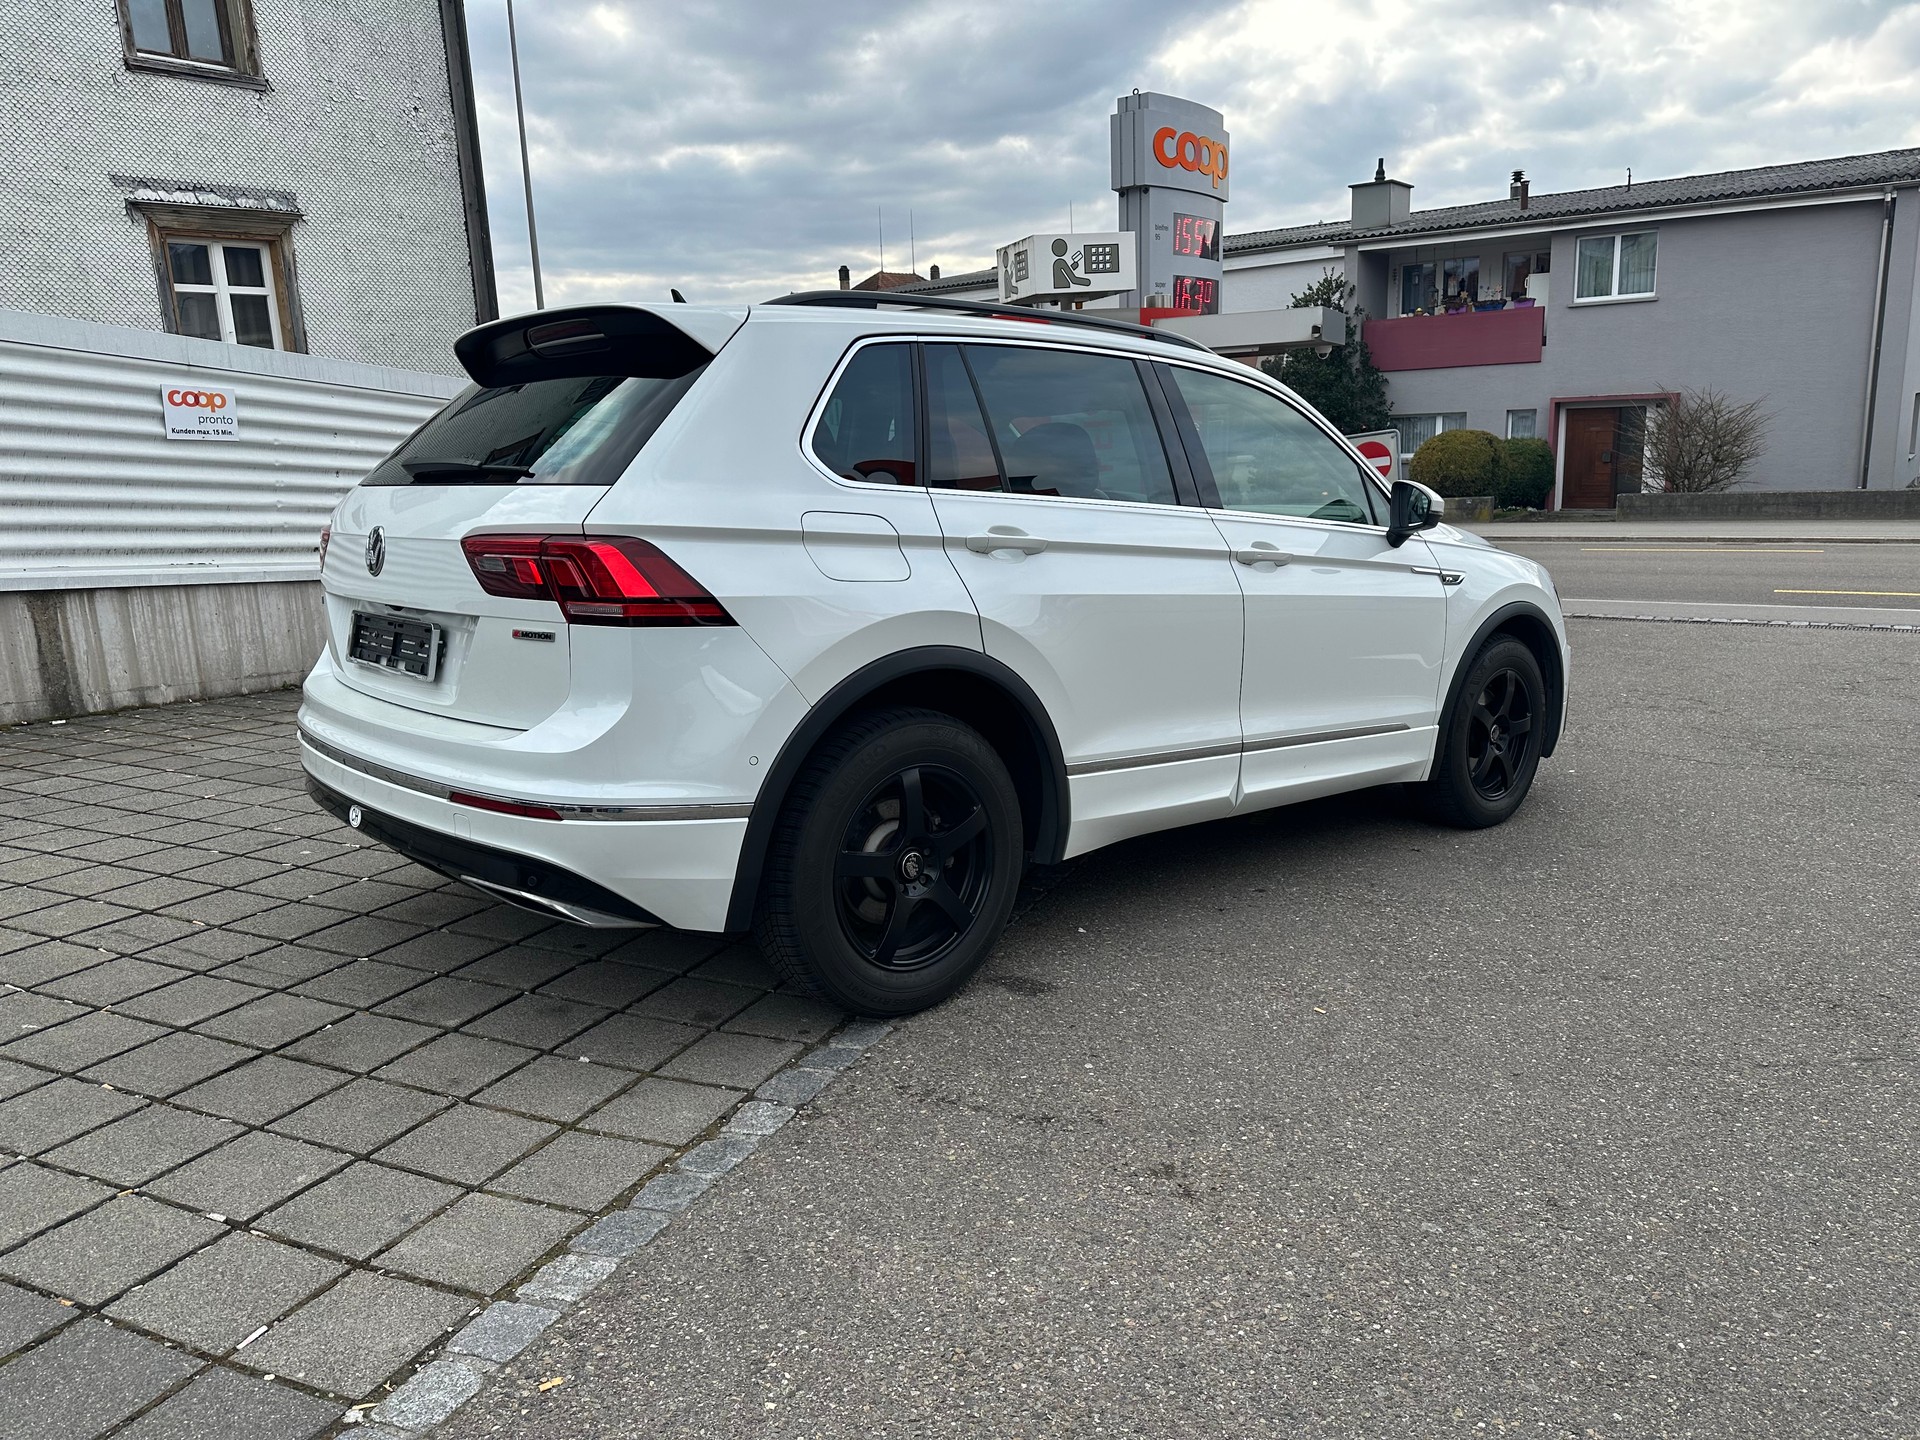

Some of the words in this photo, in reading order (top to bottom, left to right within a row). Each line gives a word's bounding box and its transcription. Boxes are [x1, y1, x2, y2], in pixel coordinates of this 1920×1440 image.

[1153, 127, 1228, 189] coop
[167, 389, 227, 413] coop
[198, 415, 234, 425] pronto
[171, 427, 196, 435] Kunden
